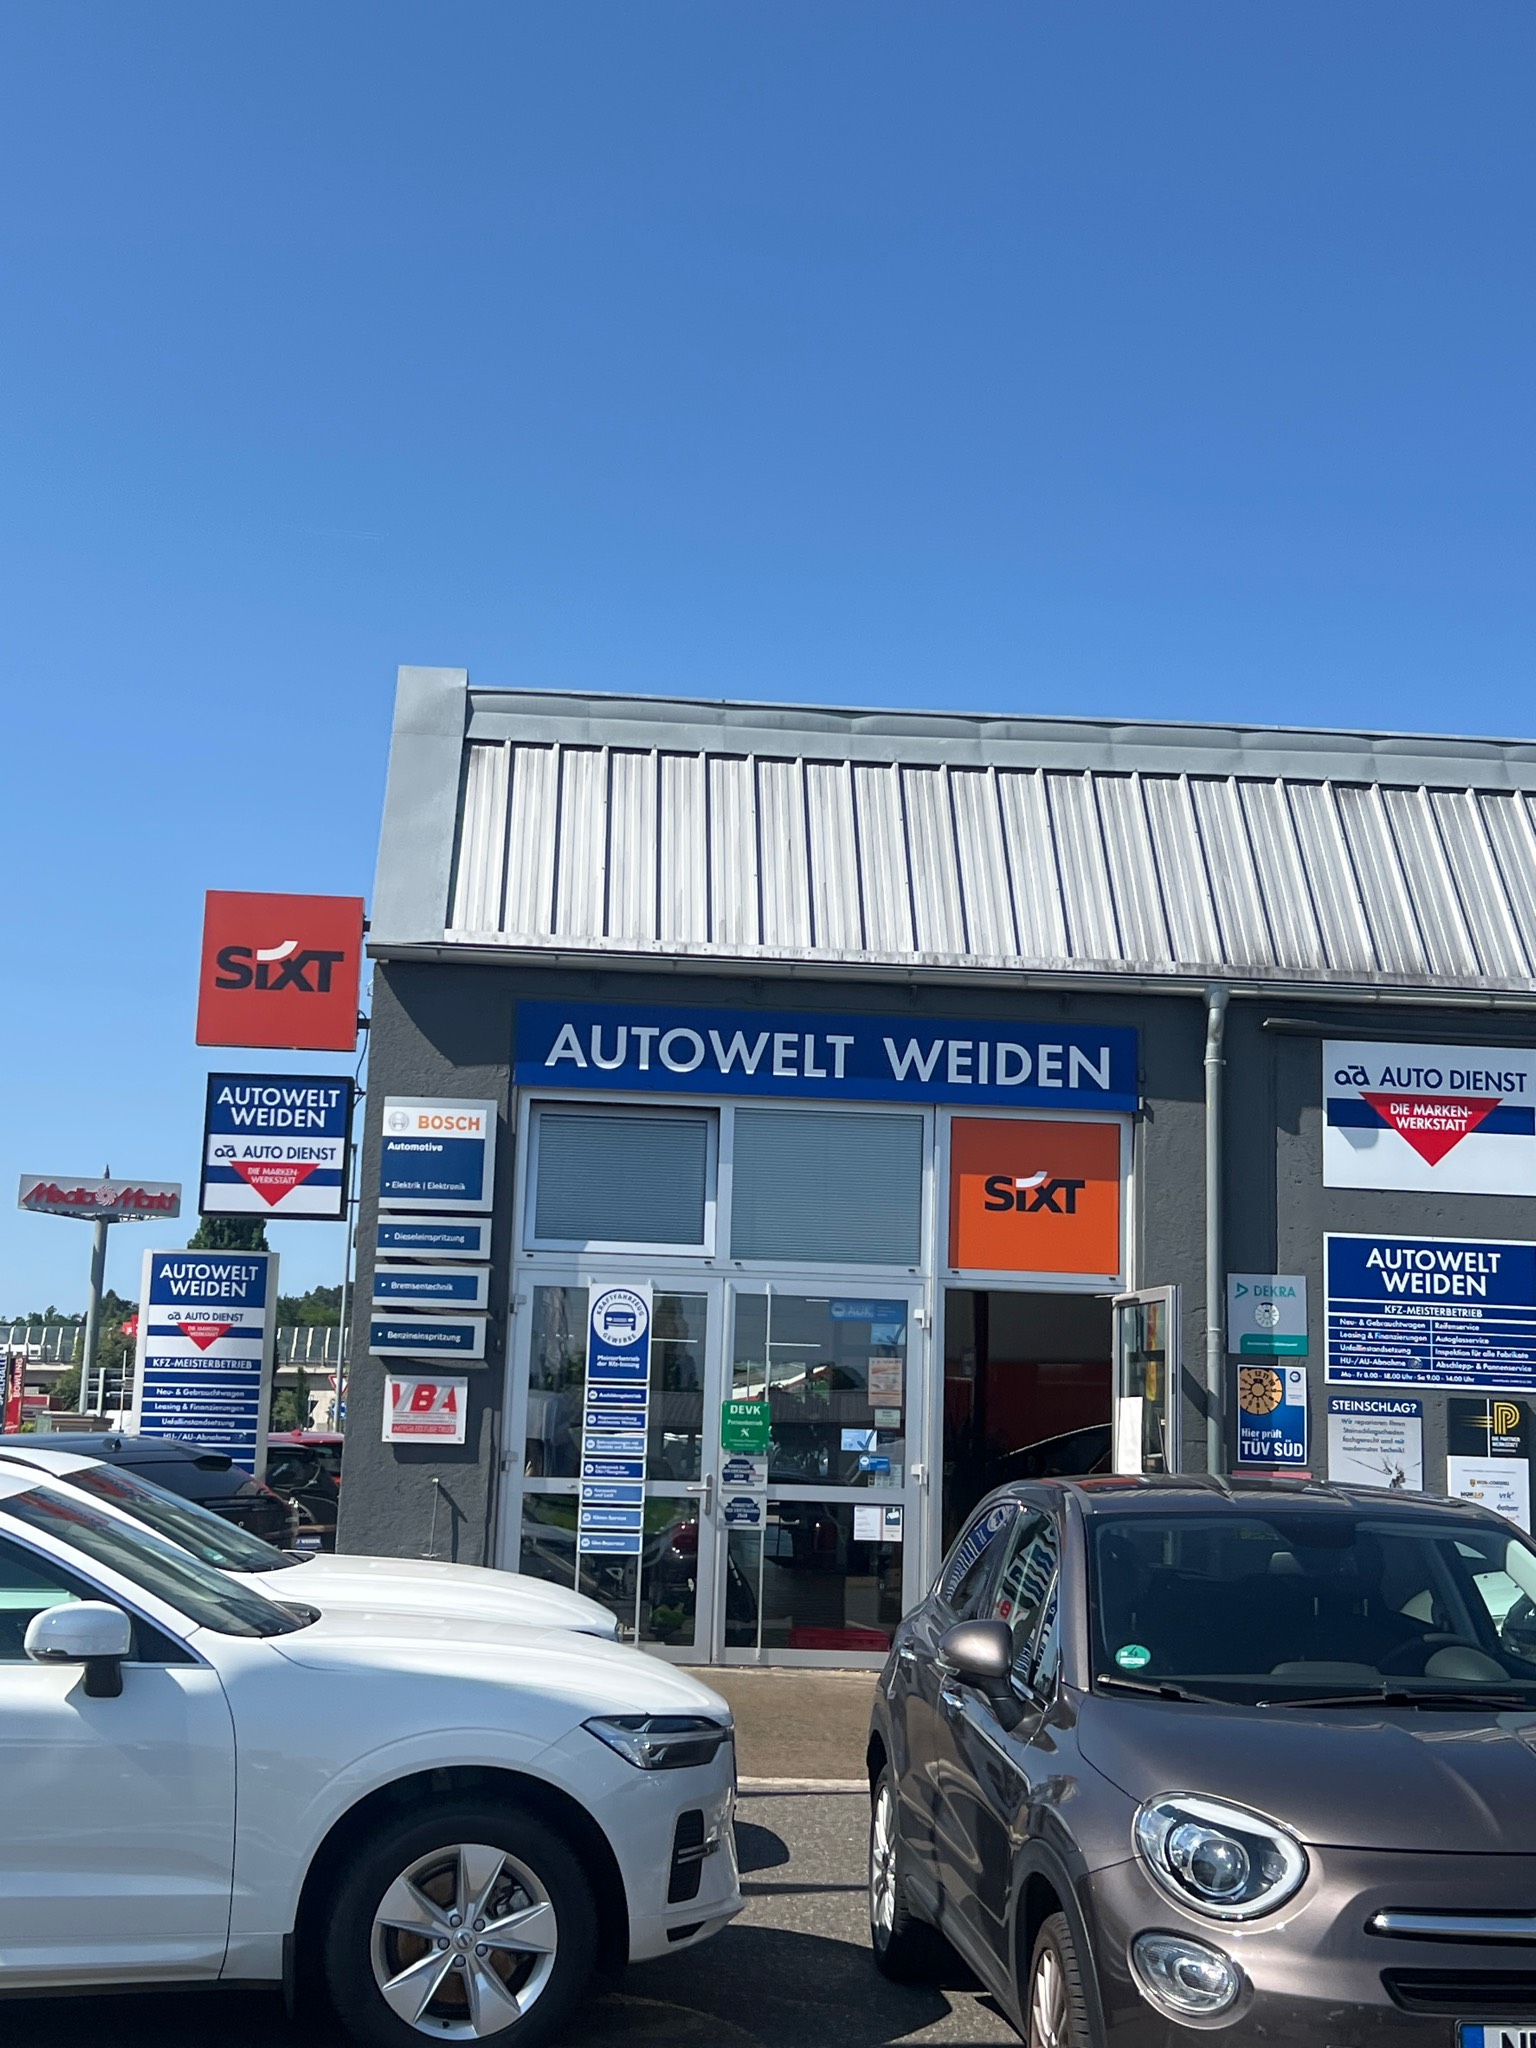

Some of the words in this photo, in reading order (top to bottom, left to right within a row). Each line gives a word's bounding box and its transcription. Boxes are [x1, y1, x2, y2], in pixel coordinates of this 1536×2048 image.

[544, 1023, 854, 1079] AUTOWELT
[883, 1037, 1111, 1090] WEIDEN
[1379, 1067, 1443, 1089] AUTO
[1450, 1070, 1527, 1093] DIENST
[217, 1087, 340, 1108] AUTOWELT
[1390, 1103, 1410, 1115] DIE
[1413, 1104, 1472, 1118] MARKEN-
[231, 1107, 325, 1128] WEIDEN
[418, 1115, 480, 1131] BOSCH
[1396, 1117, 1467, 1131] WERKSTATT
[387, 1142, 443, 1151] Automotive
[243, 1146, 282, 1159] AUTO
[286, 1146, 336, 1161] DIENST
[248, 1166, 260, 1175] DIE
[262, 1167, 300, 1177] MARKEN-
[251, 1175, 296, 1185] WERKSTATT
[392, 1181, 421, 1189] Elektrik
[427, 1181, 466, 1191] Elektronik
[394, 1232, 465, 1243] Dieseleinspritzung
[1366, 1247, 1501, 1273] AUTOWELT
[160, 1263, 258, 1281] AUTOWELT
[170, 1280, 246, 1297] WEIDEN
[391, 1282, 453, 1291] Bremsentechnik
[1381, 1271, 1486, 1297] WEIDEN
[1253, 1285, 1296, 1297] DEKRA
[596, 1293, 644, 1316] KRAFTFAHRZEUG
[185, 1312, 210, 1321] AUTO
[212, 1313, 244, 1322] DIENST
[1384, 1304, 1482, 1318] KFZ-MEISTERBETRIEB
[1366, 1319, 1426, 1330] Gebrauchtwagen
[1434, 1322, 1479, 1331] Reifenservice
[387, 1331, 461, 1343] Benzineinspritzung
[602, 1332, 637, 1343] GEWERBE
[1339, 1331, 1366, 1340] Leasing
[1374, 1332, 1427, 1342] Finanzierungen
[1435, 1335, 1489, 1345] Autoglasservice
[1340, 1344, 1411, 1355] Unfallinstandsetzung
[1435, 1349, 1470, 1358] Inspektion
[1471, 1349, 1481, 1358] für
[1482, 1350, 1495, 1358] alle
[1496, 1351, 1529, 1359] Fabrikate
[153, 1358, 252, 1369] KFZ-MEISTERBETRIEB
[1340, 1357, 1406, 1366] HU-/AU-Abnahme
[1436, 1361, 1474, 1372] Abschlepp-
[1483, 1363, 1532, 1373] Pannenservice
[12, 1357, 24, 1398] BOWLING
[156, 1388, 174, 1396] Neu-
[183, 1388, 245, 1399] Gebrauchtwagen
[392, 1383, 457, 1412] VBA
[155, 1403, 180, 1412] Leasing
[190, 1403, 244, 1413] Finanzierungen
[730, 1405, 760, 1415] DEVK
[1332, 1400, 1417, 1414] STEINSCHLAG?
[1241, 1428, 1260, 1437] Hier
[1262, 1429, 1282, 1439] prüft
[1241, 1438, 1270, 1456] TÜV
[1274, 1439, 1303, 1457] SÜD
